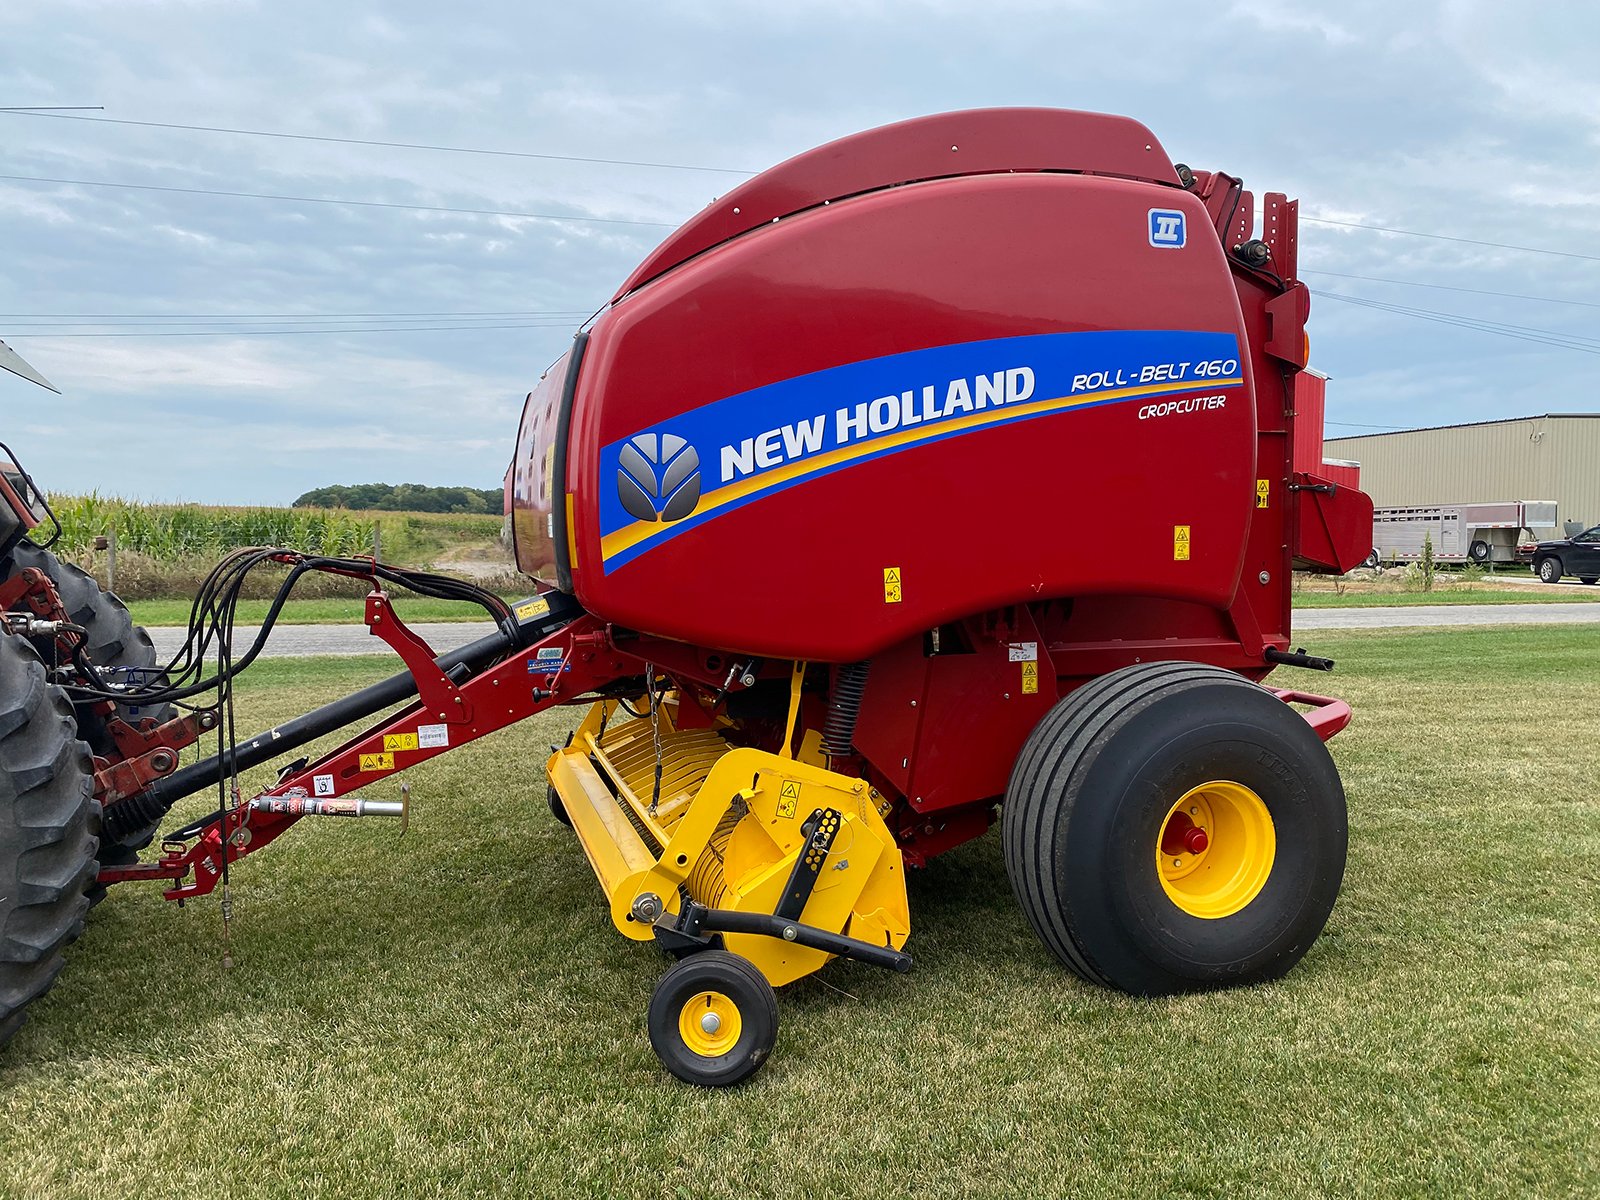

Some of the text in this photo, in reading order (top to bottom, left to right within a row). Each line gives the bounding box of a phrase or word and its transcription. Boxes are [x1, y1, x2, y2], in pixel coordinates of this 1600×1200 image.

[1071, 359, 1237, 393] ROLL-BELT 460
[720, 366, 1036, 482] NEW HOLLAND
[1138, 395, 1226, 420] CROPCUTTER
